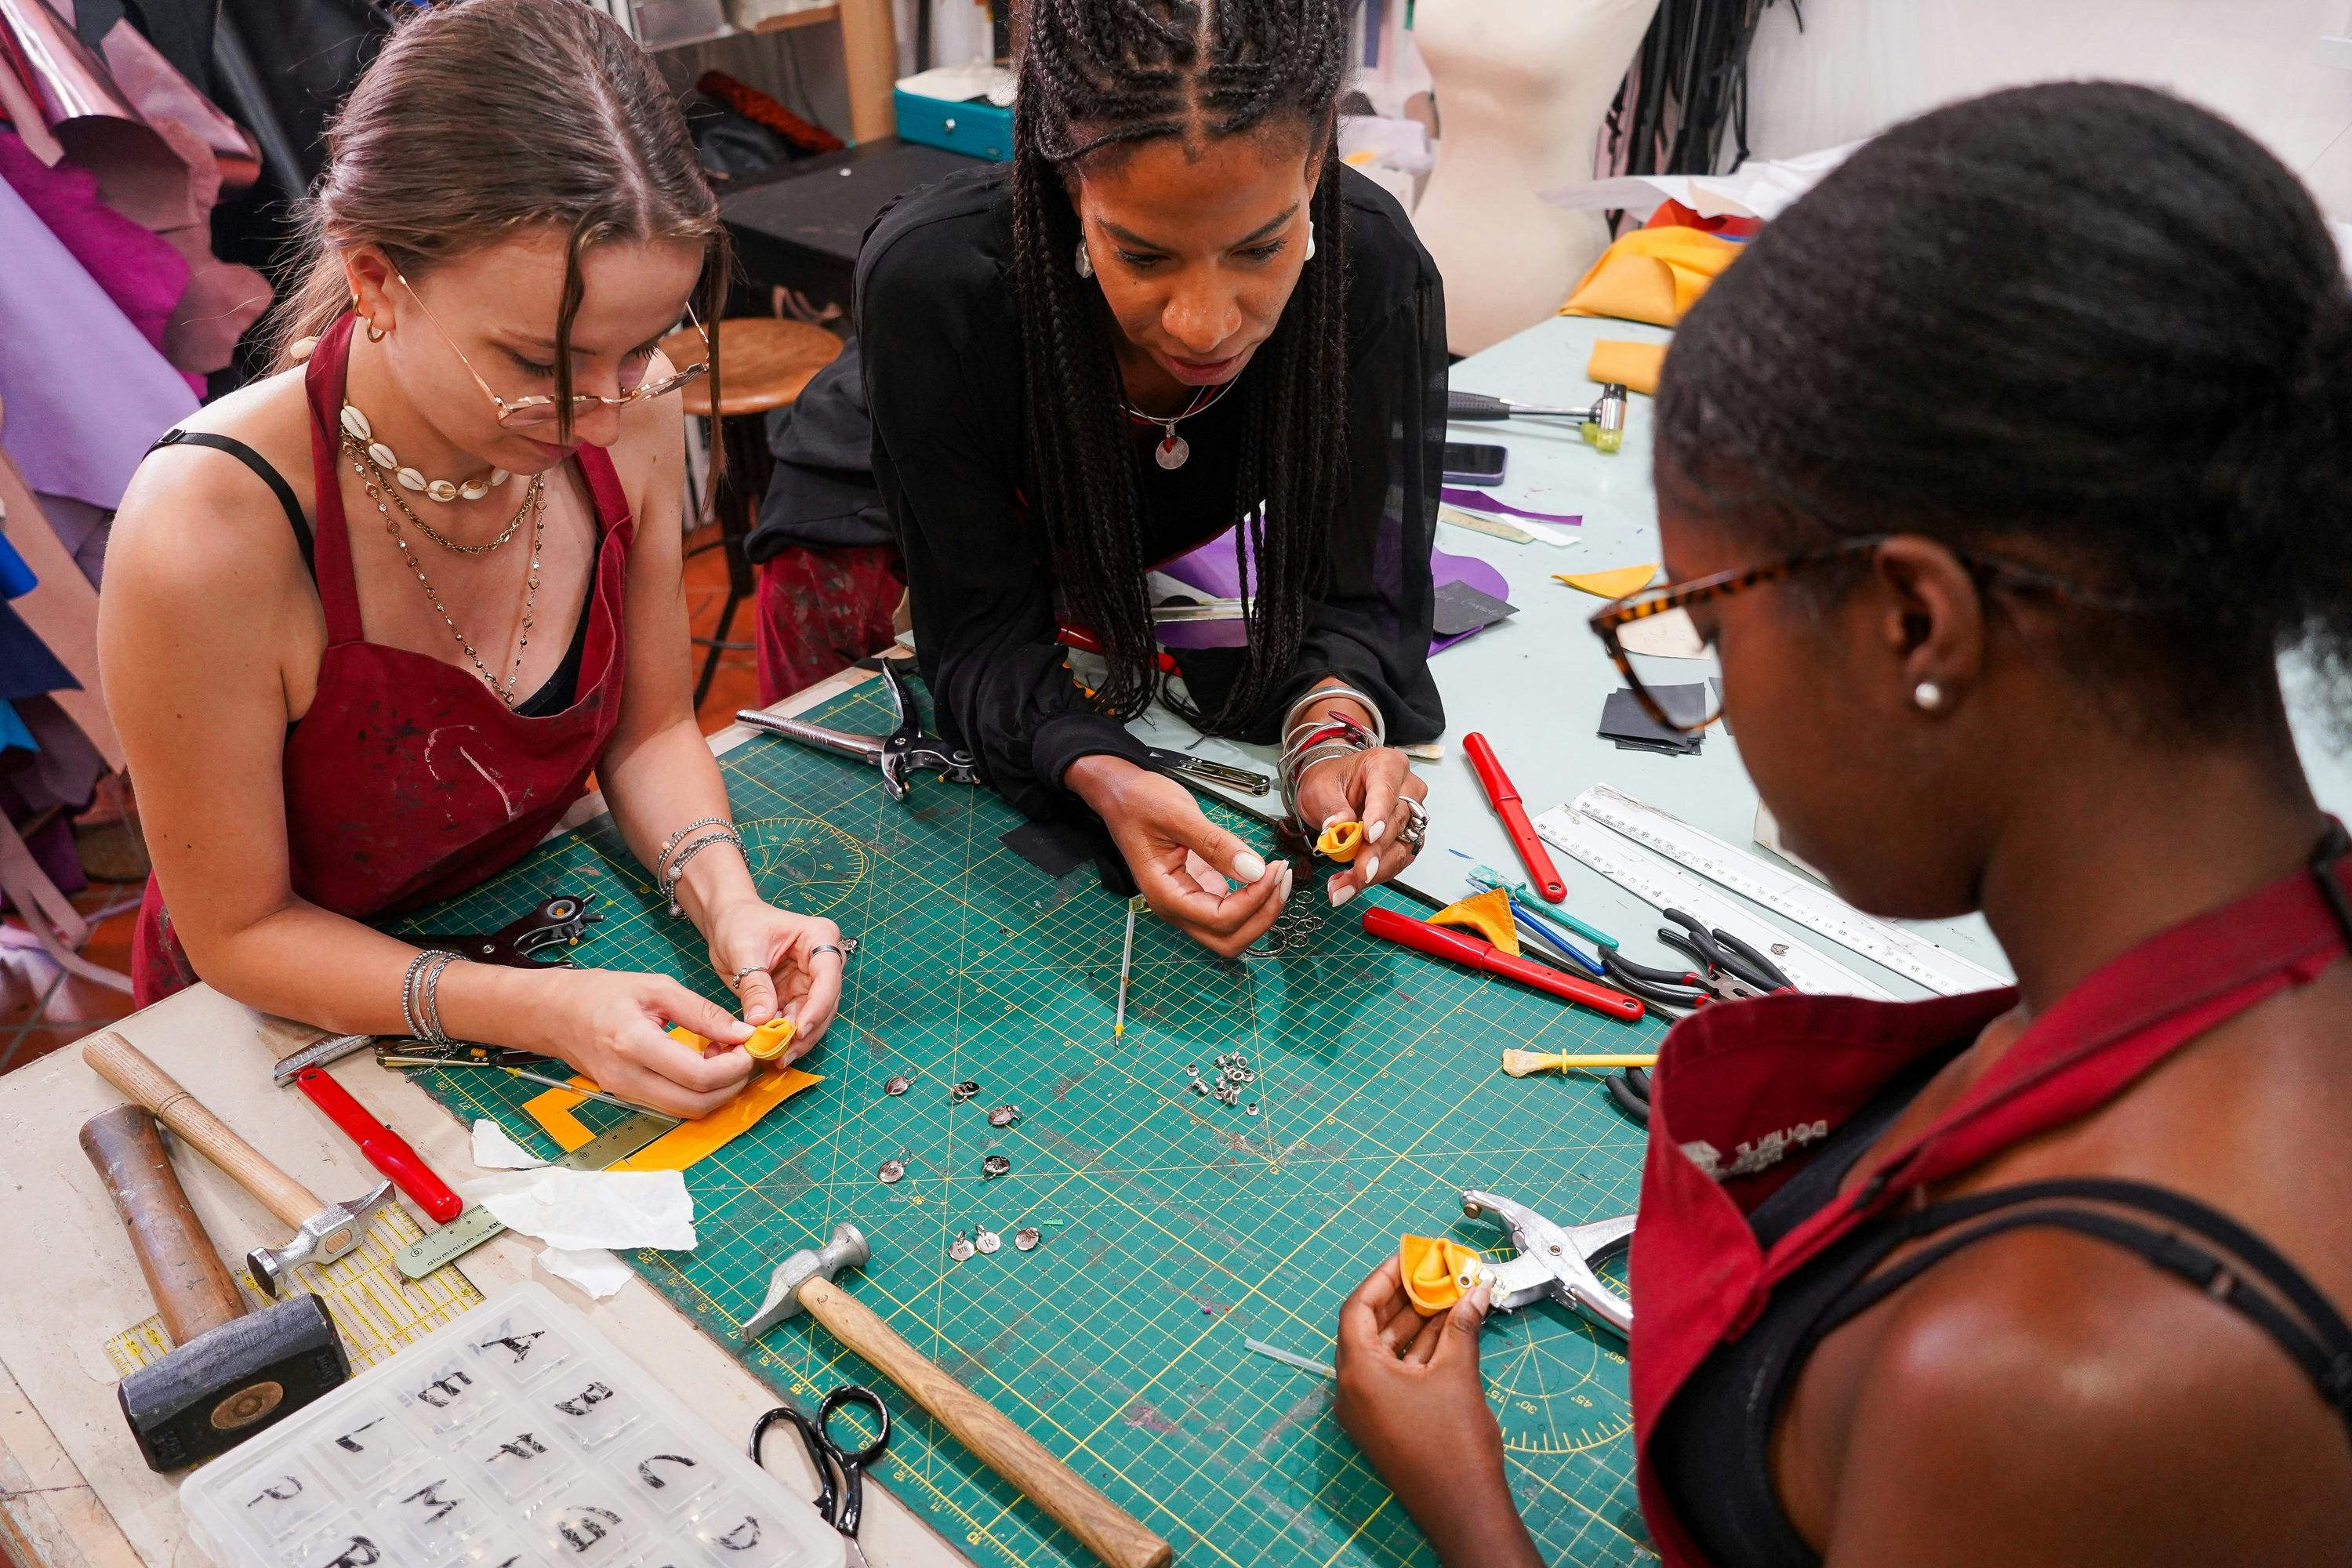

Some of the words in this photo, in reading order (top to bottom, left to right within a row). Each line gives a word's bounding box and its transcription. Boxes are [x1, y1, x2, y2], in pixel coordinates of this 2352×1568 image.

[436, 1081, 448, 1091] 28
[459, 1102, 471, 1110] 27
[909, 1195, 924, 1205] 90°
[984, 1238, 994, 1247] R
[427, 1237, 474, 1266] aluminium
[957, 1246, 968, 1254] DTB
[637, 1252, 653, 1264] 20
[668, 1277, 678, 1287] 19
[697, 1302, 706, 1312] 18
[481, 1330, 545, 1363] A
[759, 1356, 770, 1367] 16
[1604, 1352, 1626, 1365] 60°
[418, 1370, 473, 1408] E
[790, 1383, 804, 1395] 15
[554, 1381, 614, 1417] B
[1570, 1395, 1593, 1408] 45°
[1515, 1400, 1537, 1414] 30°
[638, 1454, 698, 1489] C
[893, 1470, 906, 1482] 12
[399, 1478, 466, 1524] M
[712, 1515, 762, 1551] D
[966, 1531, 982, 1546] 10
